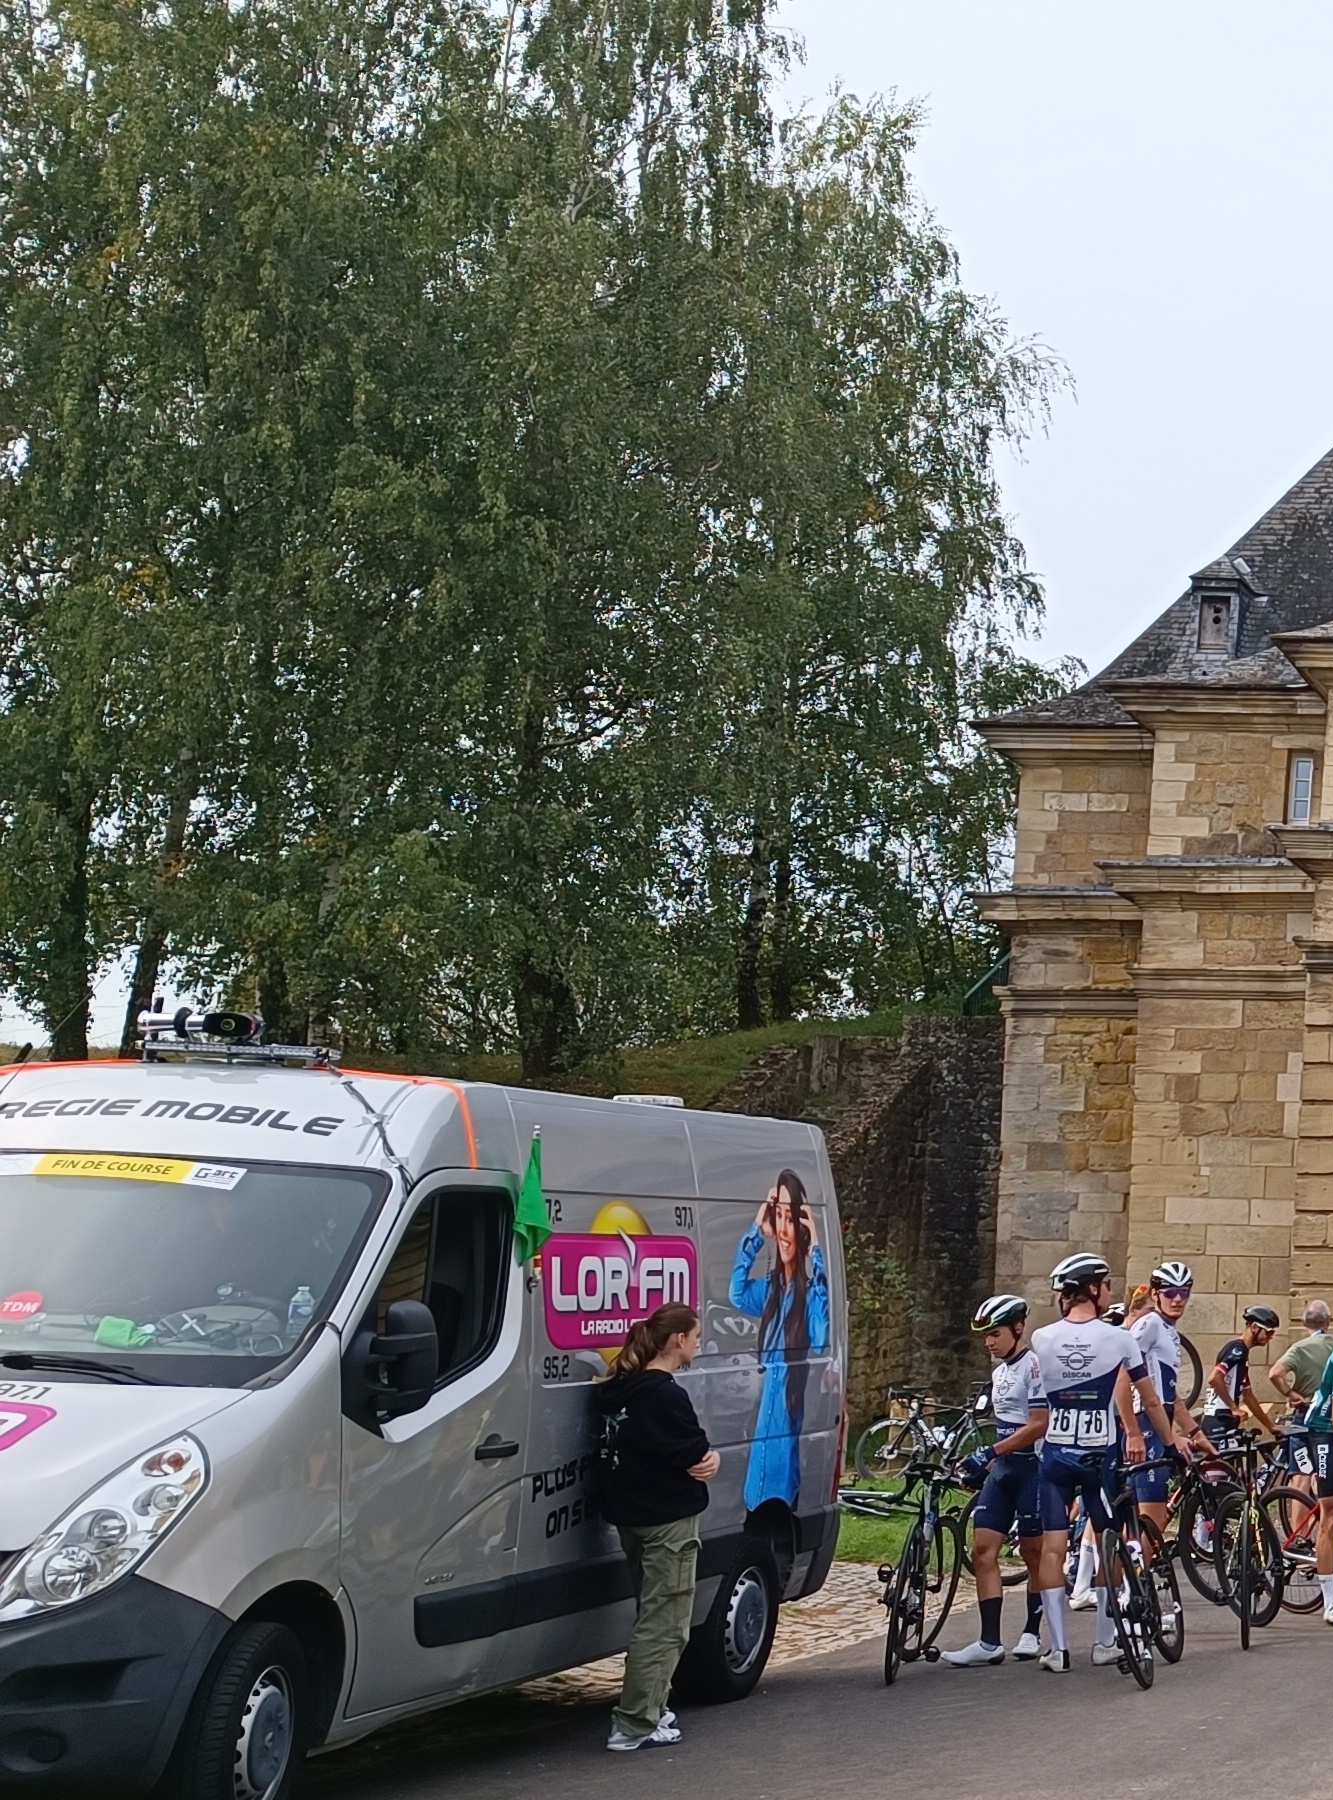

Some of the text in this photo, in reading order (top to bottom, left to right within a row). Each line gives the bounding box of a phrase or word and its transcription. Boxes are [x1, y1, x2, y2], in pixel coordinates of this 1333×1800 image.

[141, 1100, 345, 1136] MOBILE
[52, 1159, 175, 1175] FIN DE COURSE
[545, 1199, 562, 1224] 7,2
[675, 1207, 693, 1230] 97,1
[2, 1301, 39, 1313] TDM
[581, 1321, 594, 1335] LA
[596, 1319, 624, 1334] RADIO
[544, 1355, 569, 1381] 95,2
[1053, 1408, 1071, 1432] 76
[1084, 1410, 1103, 1434] 76
[532, 1459, 578, 1503] PLUS
